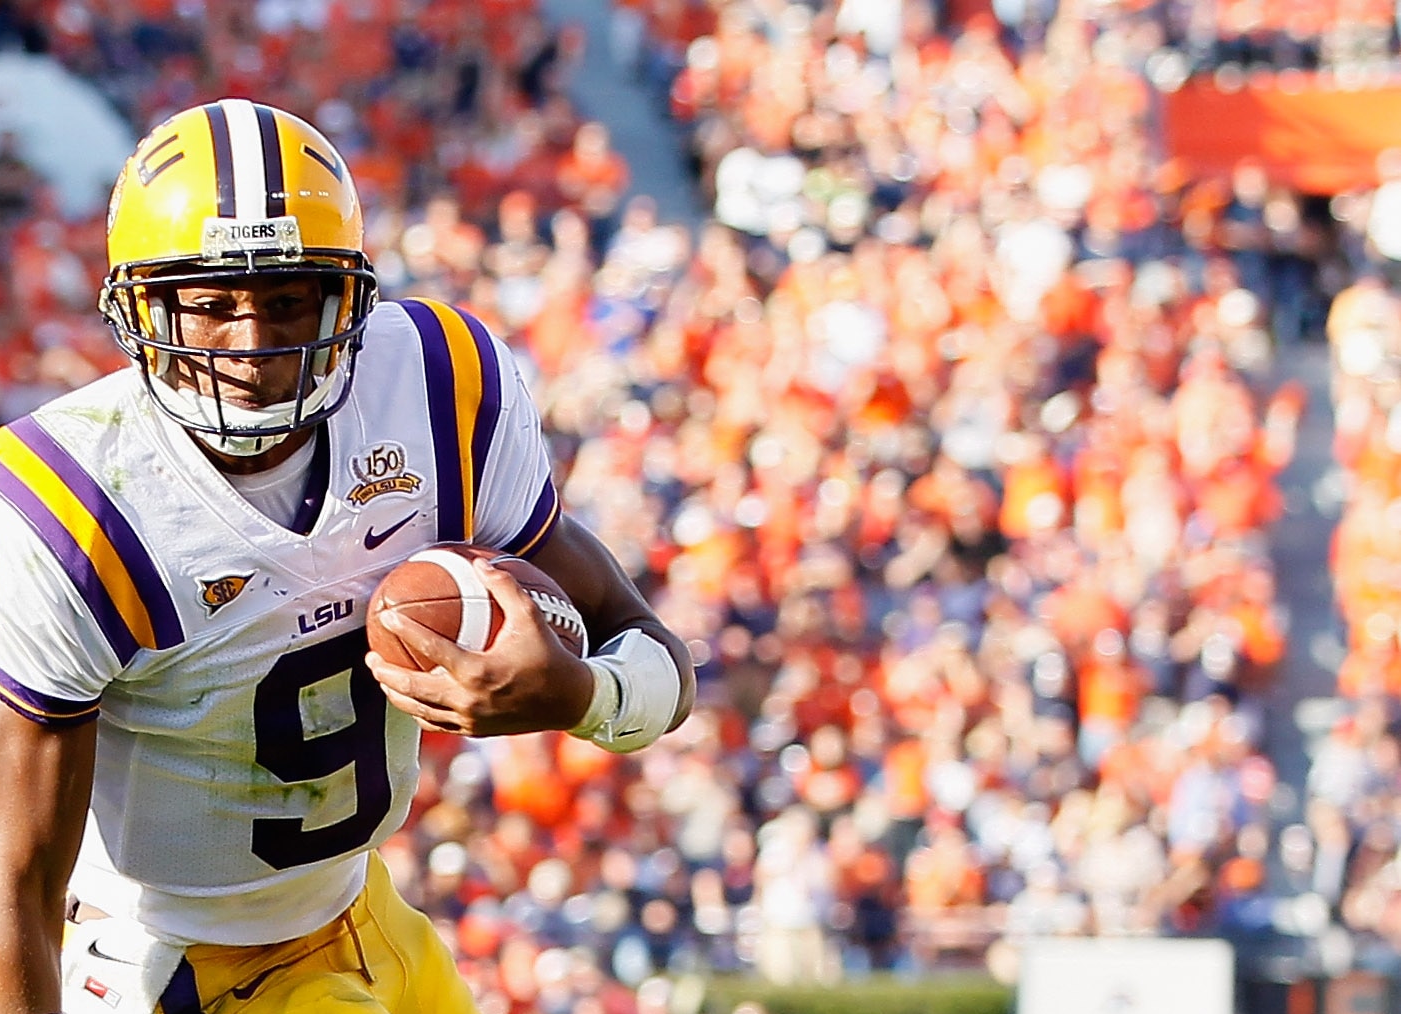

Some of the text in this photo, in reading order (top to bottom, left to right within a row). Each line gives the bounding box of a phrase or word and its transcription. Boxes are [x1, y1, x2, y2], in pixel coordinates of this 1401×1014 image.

[230, 224, 276, 239] TIGERS
[364, 445, 399, 477] 150
[373, 480, 397, 493] LSU
[211, 579, 237, 603] SEC
[297, 598, 354, 634] LSU
[251, 624, 393, 871] 9
